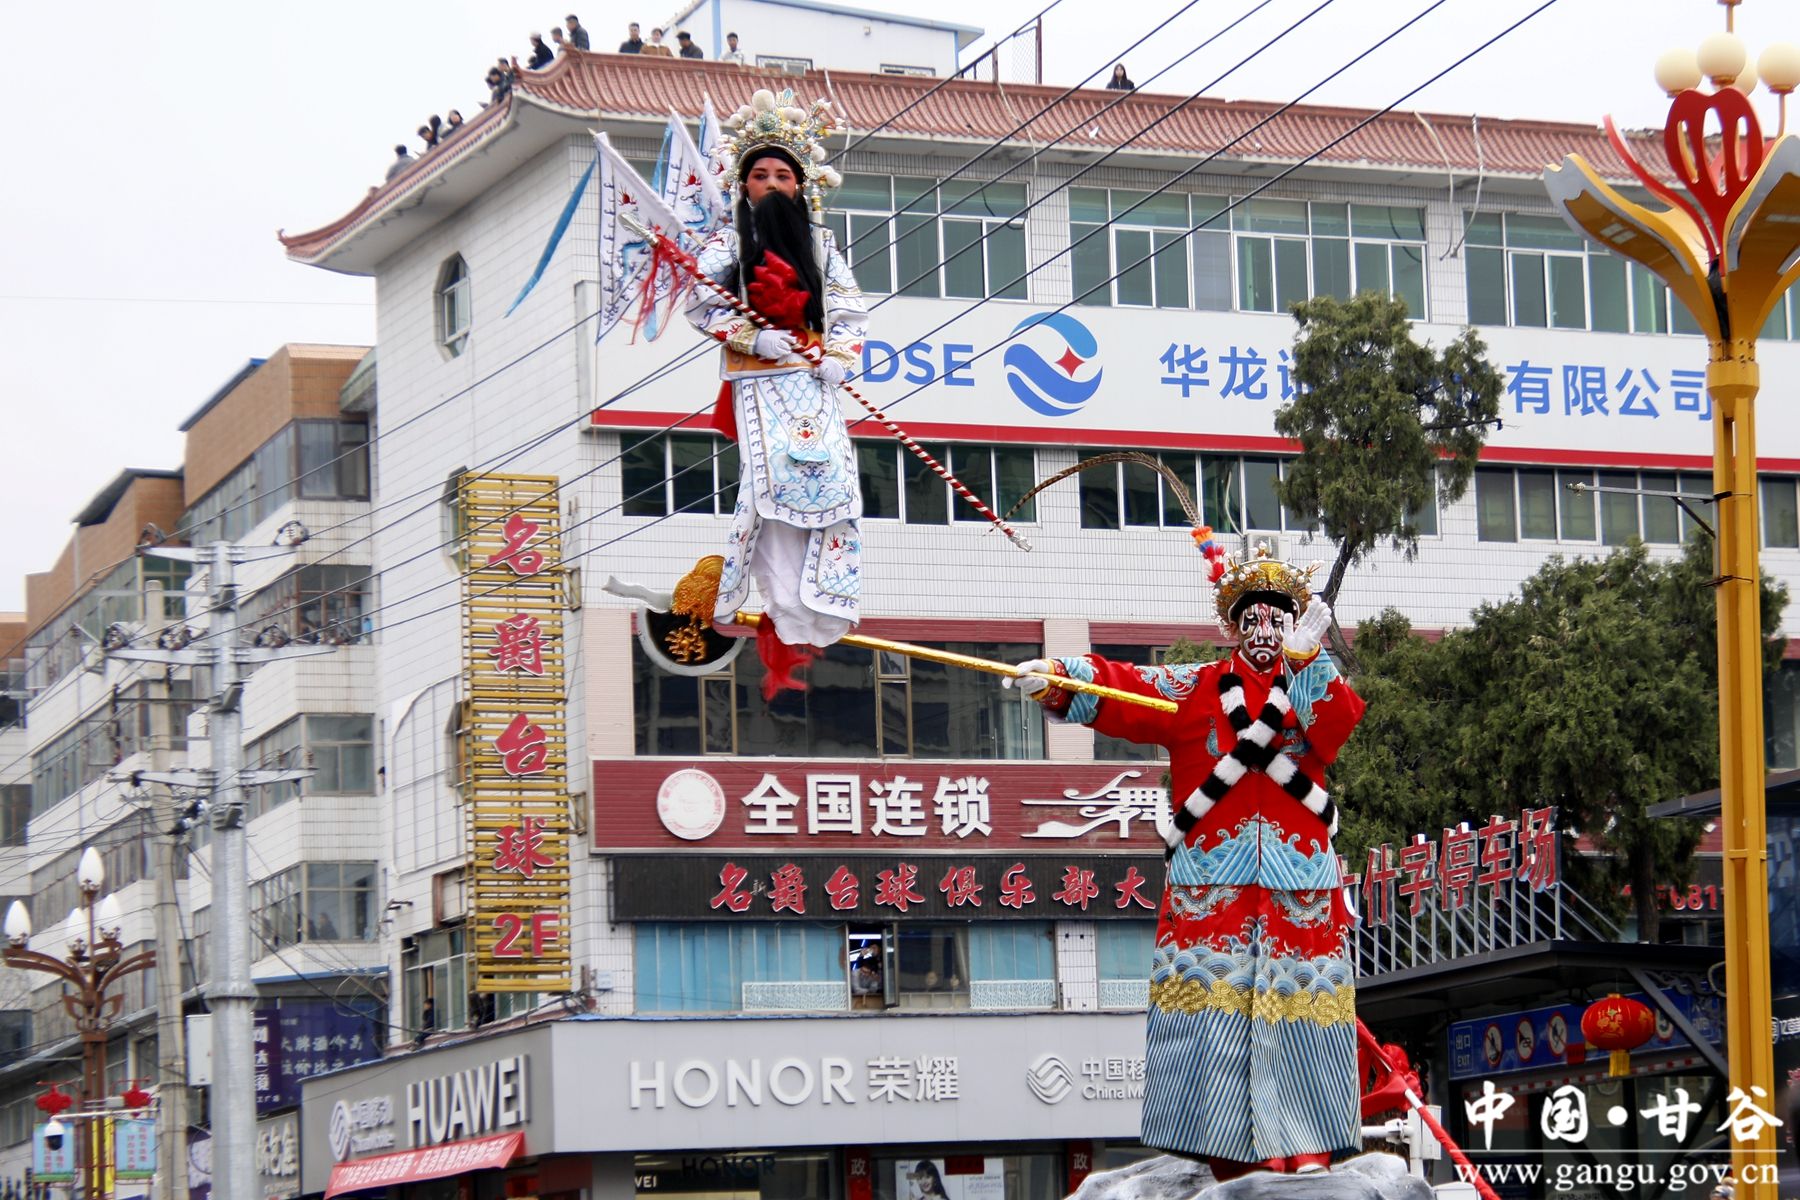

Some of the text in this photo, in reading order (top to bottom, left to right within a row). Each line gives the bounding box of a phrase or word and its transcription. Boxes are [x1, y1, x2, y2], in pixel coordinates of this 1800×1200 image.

[845, 339, 975, 387] DSE
[487, 513, 556, 880] 名爵台球
[741, 773, 993, 838] 全国连锁
[709, 861, 1157, 915] 名爵台球俱乐部大
[493, 912, 560, 958] 2F
[630, 1055, 960, 1108] HONOR 荣耀
[1456, 1054, 1471, 1067] EXIT
[406, 1054, 530, 1147] HUAWEI
[1082, 1084, 1125, 1100] China
[682, 1155, 776, 1178] HONOR
[851, 1158, 866, 1176] 政
[1073, 1153, 1088, 1170] 政
